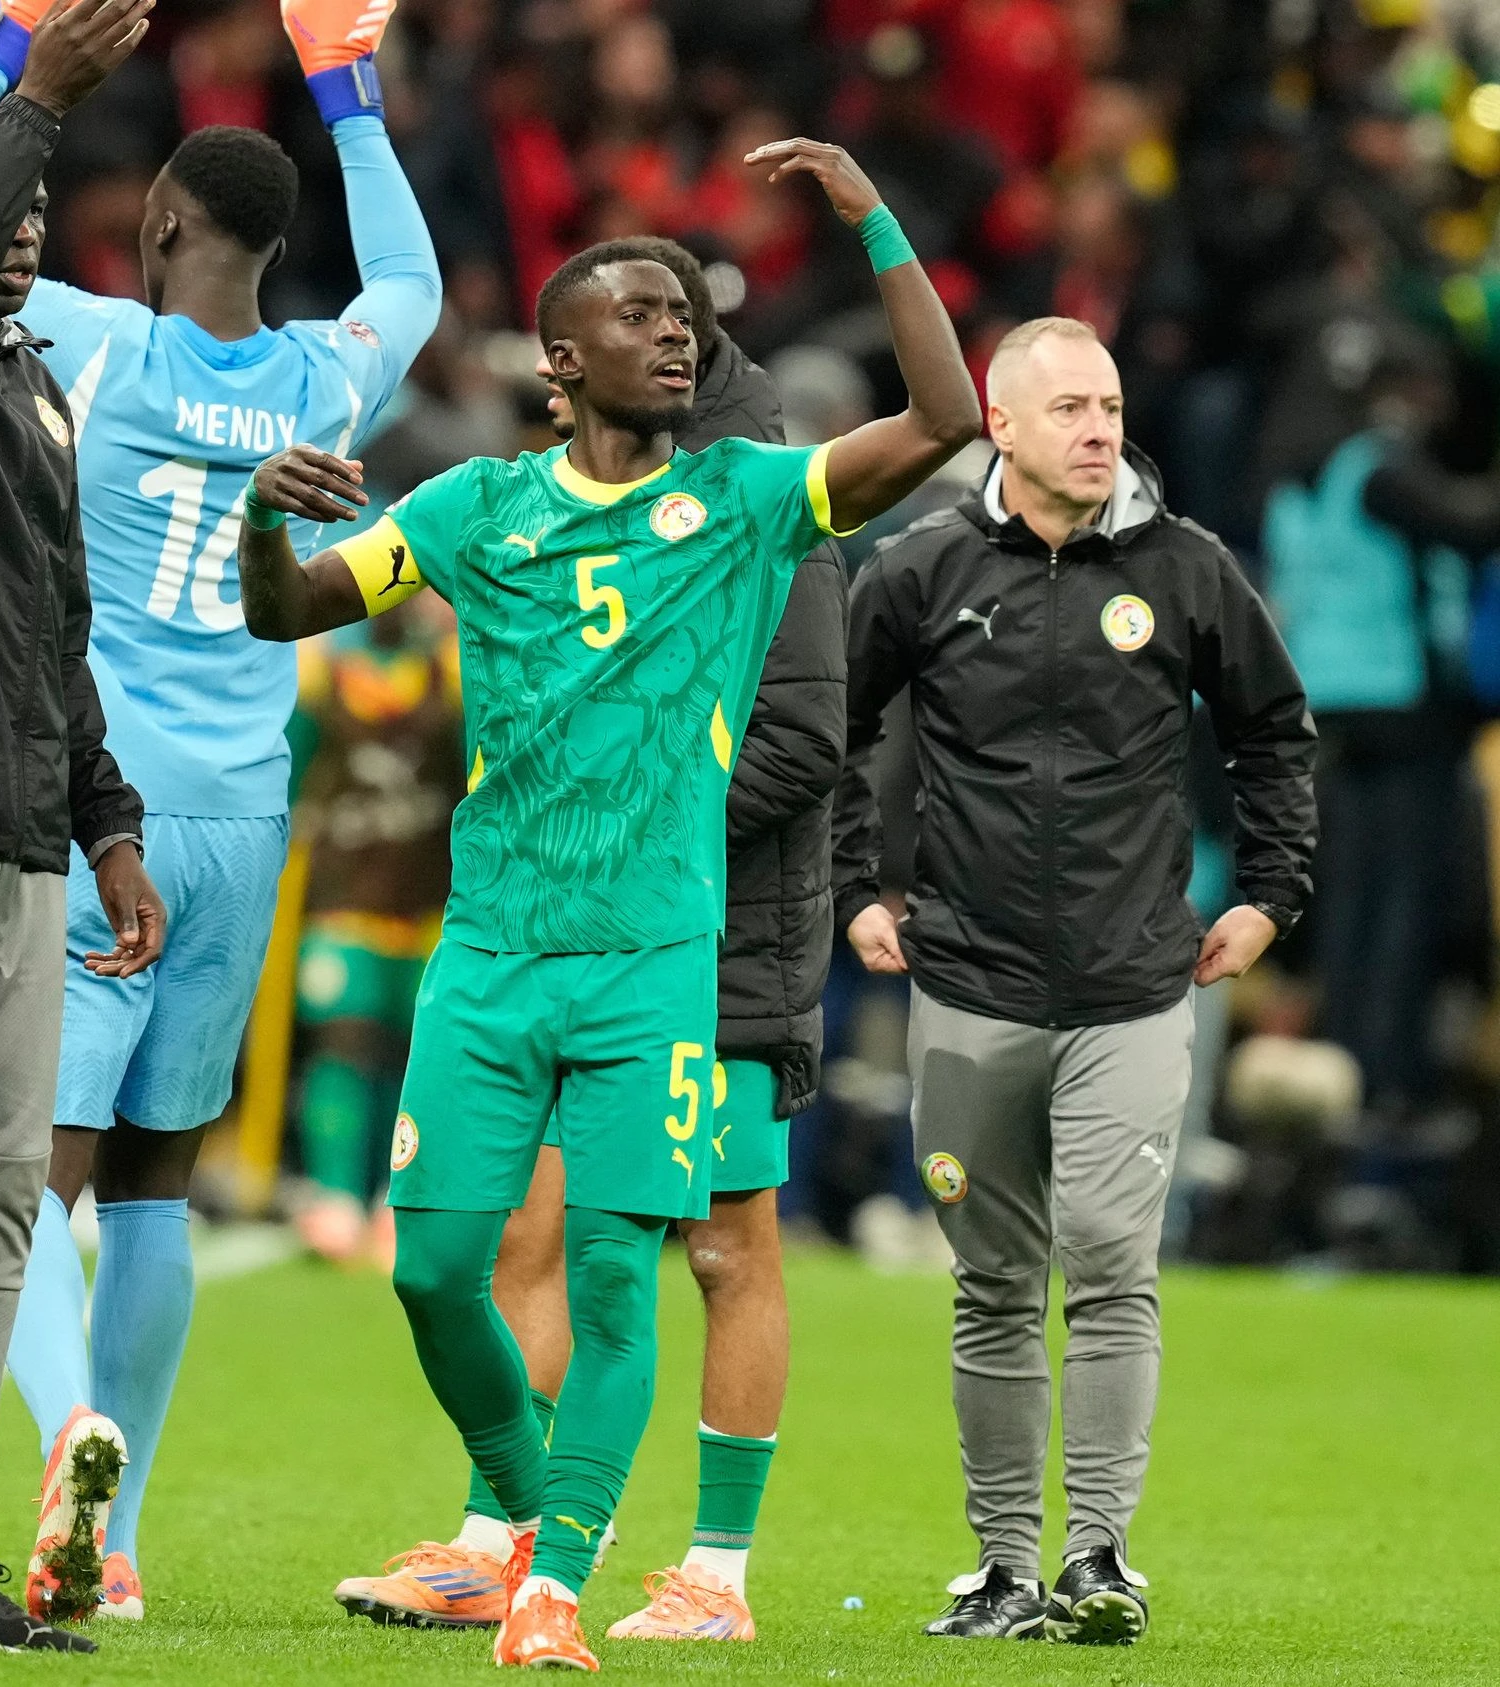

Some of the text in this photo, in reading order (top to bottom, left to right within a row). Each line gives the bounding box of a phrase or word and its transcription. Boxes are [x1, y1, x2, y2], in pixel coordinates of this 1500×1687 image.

[175, 396, 297, 453] MENDY
[575, 554, 627, 649] 5
[664, 1041, 703, 1142] 5
